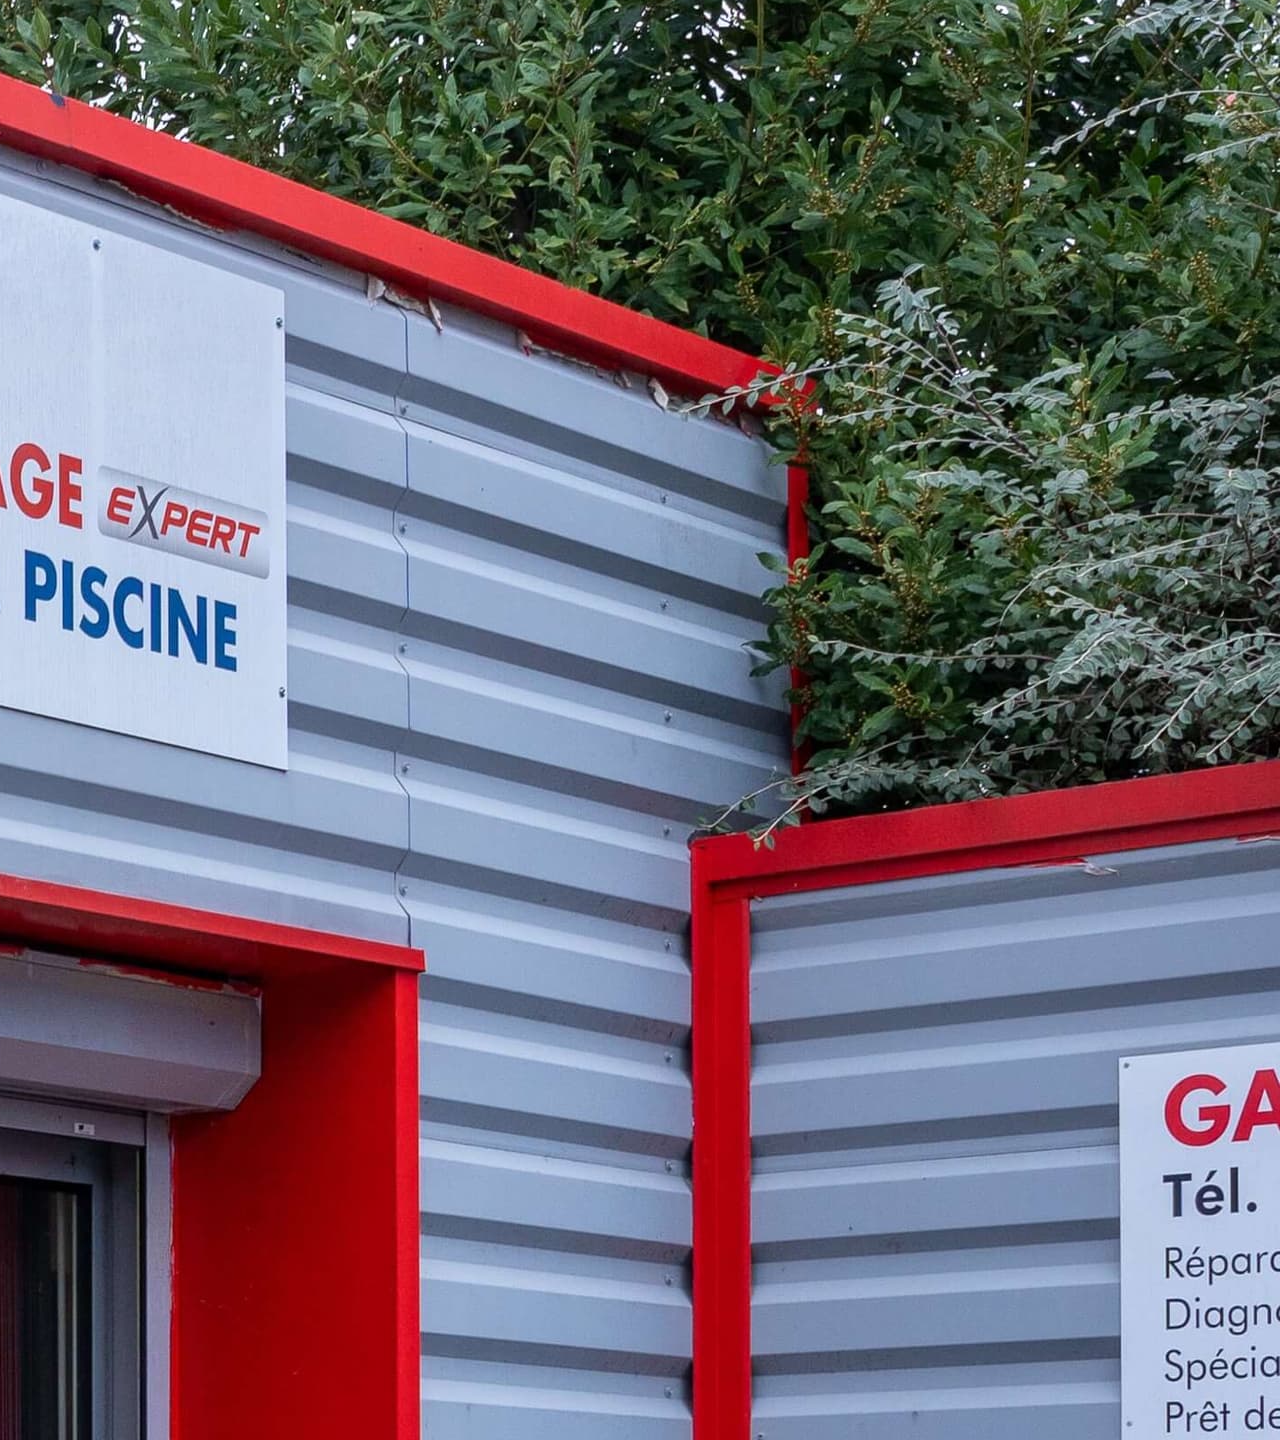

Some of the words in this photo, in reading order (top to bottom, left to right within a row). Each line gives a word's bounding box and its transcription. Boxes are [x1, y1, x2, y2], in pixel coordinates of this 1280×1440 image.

[107, 486, 260, 557] EXPERT
[25, 549, 237, 672] PISCINE
[1163, 1167, 1257, 1217] Tél.
[1166, 1297, 1280, 1335] Diagn
[1167, 1401, 1230, 1432] Prêt
